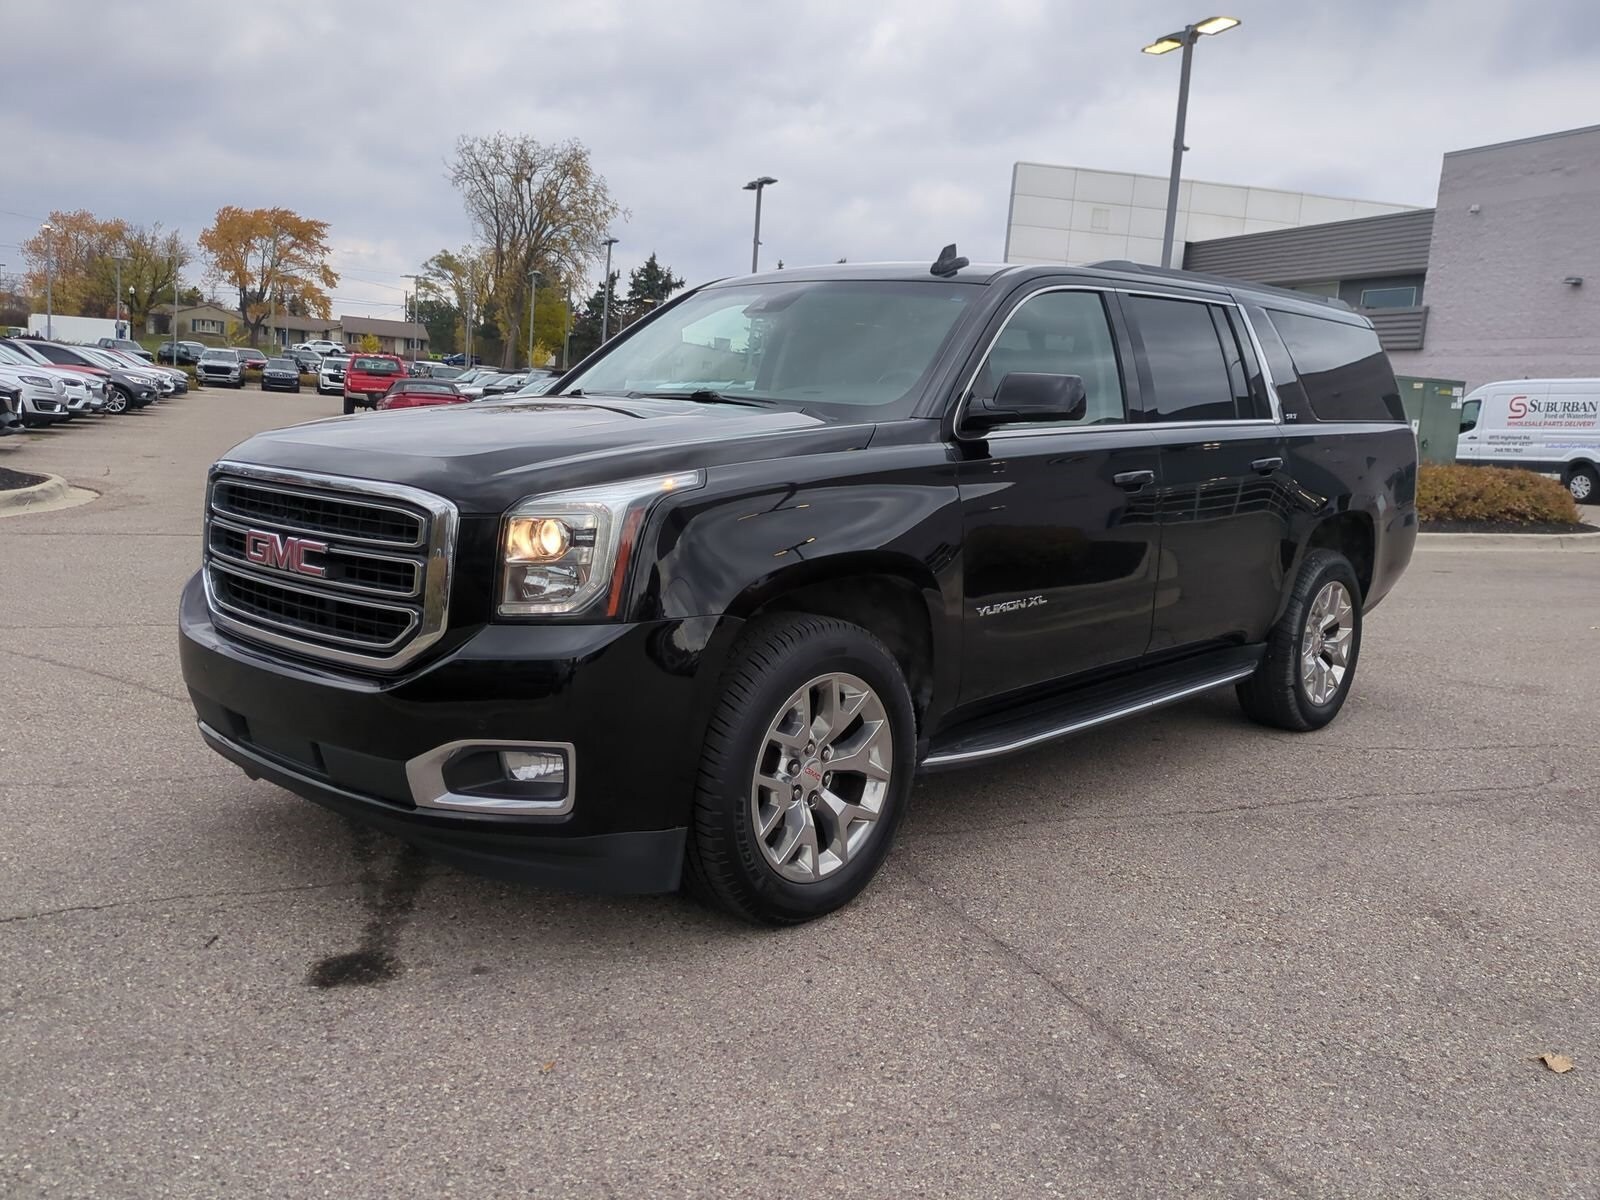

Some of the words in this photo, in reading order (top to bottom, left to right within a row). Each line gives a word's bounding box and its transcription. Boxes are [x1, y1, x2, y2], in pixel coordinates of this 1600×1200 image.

[1528, 399, 1598, 413] SUBURBAN
[246, 529, 328, 578] GMC
[976, 598, 1027, 617] YUKON
[1027, 595, 1048, 608] XL
[804, 767, 821, 781] GMC
